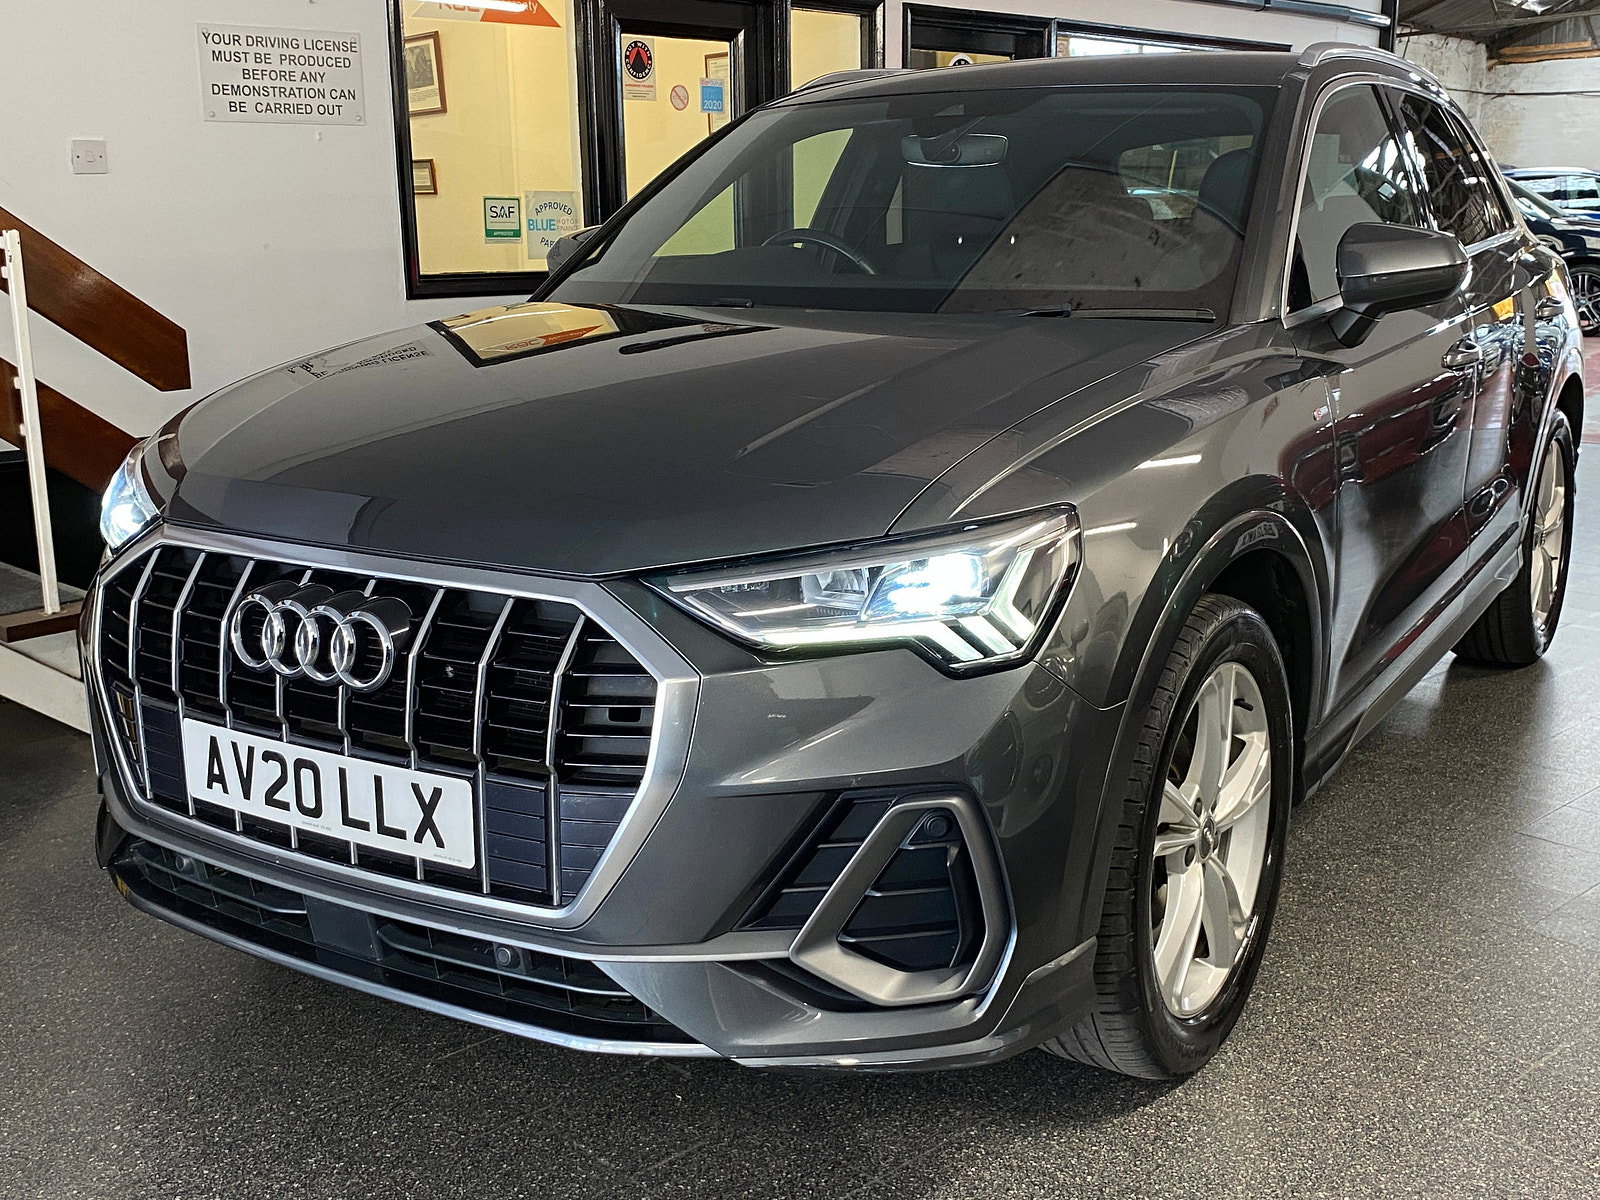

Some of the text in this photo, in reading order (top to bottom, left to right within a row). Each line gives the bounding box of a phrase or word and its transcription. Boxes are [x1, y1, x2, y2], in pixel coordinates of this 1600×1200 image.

[202, 32, 358, 53] YOUR DRIVING LICENSE
[212, 50, 351, 68] MUST BE PRODUCED
[242, 68, 326, 83] BEFORE ANY
[211, 84, 356, 100] DEMONSTRATION CAN
[229, 101, 342, 115] BE CARRIED OUT
[703, 100, 723, 110] 2020
[489, 205, 515, 218] SAF
[535, 201, 573, 216] APPROVED
[528, 218, 556, 231] BLUE
[206, 735, 446, 849] AV20 LLX
